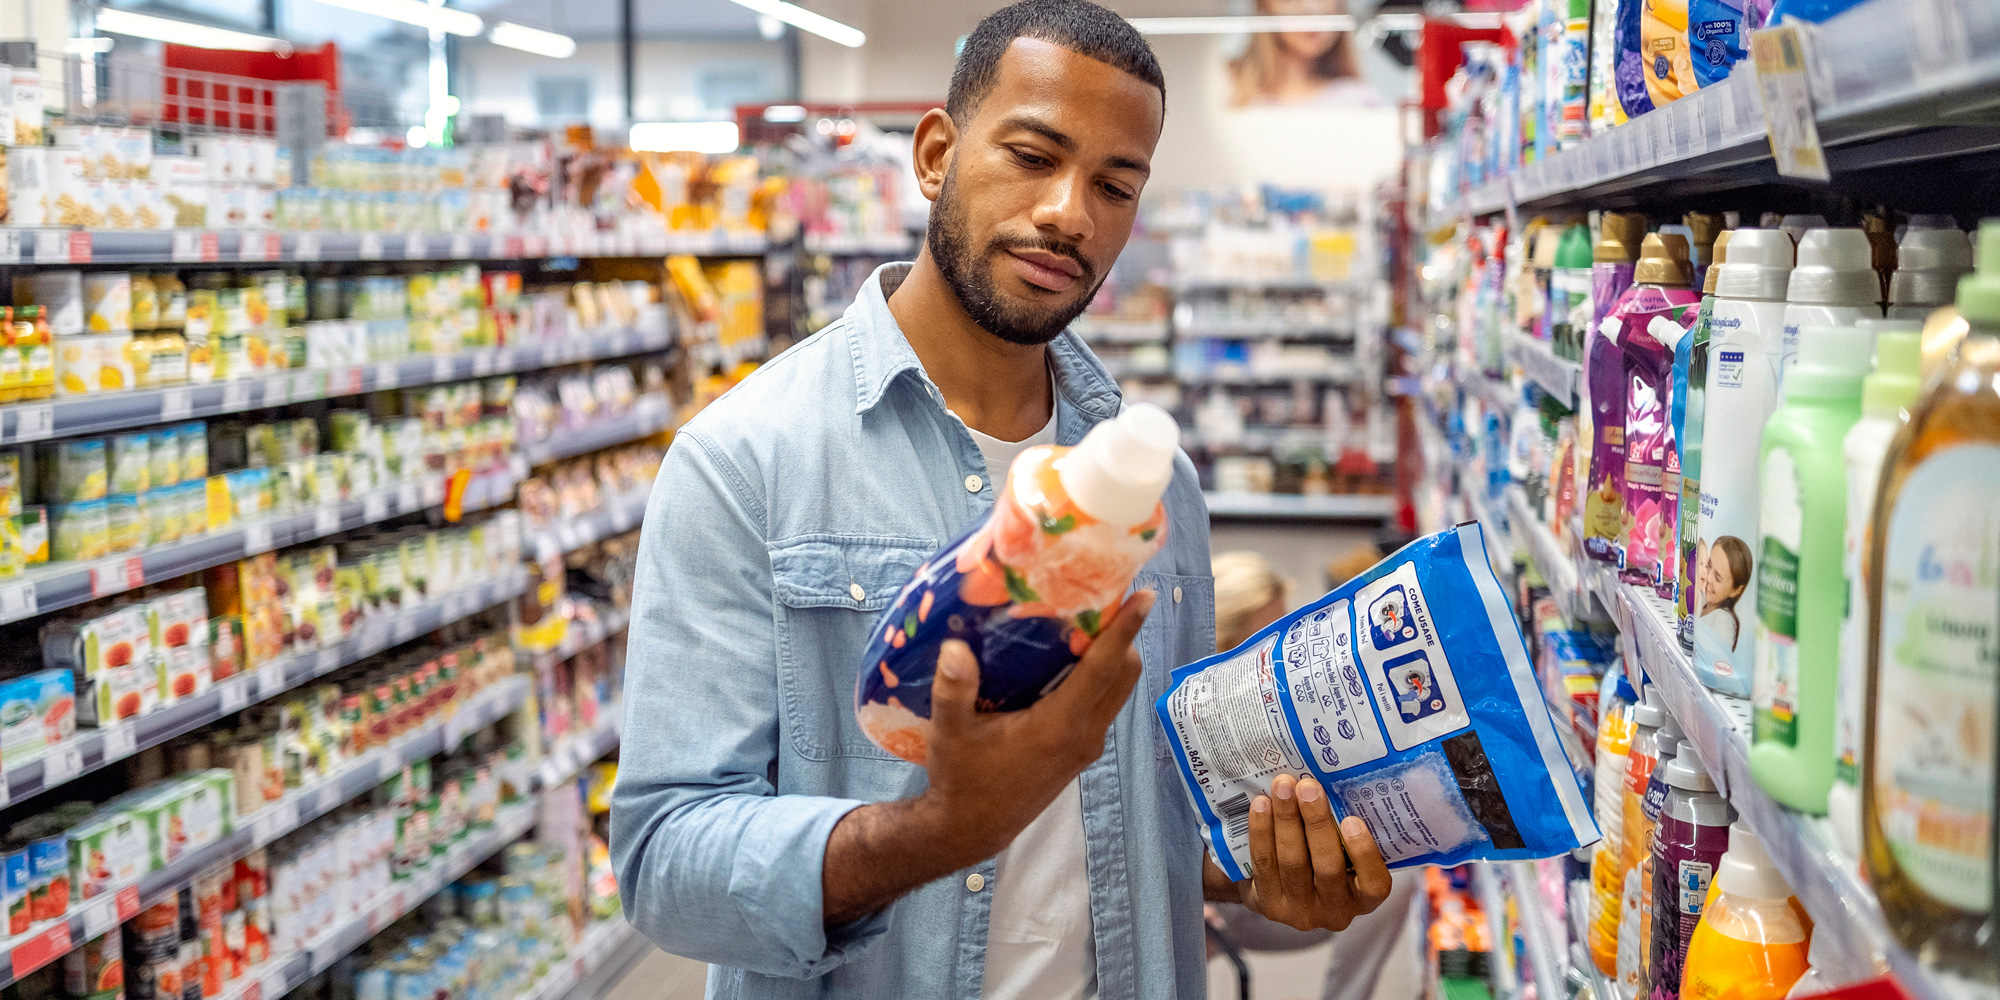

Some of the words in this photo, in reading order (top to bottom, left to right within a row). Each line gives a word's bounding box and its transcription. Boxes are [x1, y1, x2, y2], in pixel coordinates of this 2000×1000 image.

[1409, 588, 1422, 614] COME
[1418, 616, 1434, 646] USARE
[1189, 750, 1208, 776] 862,4
